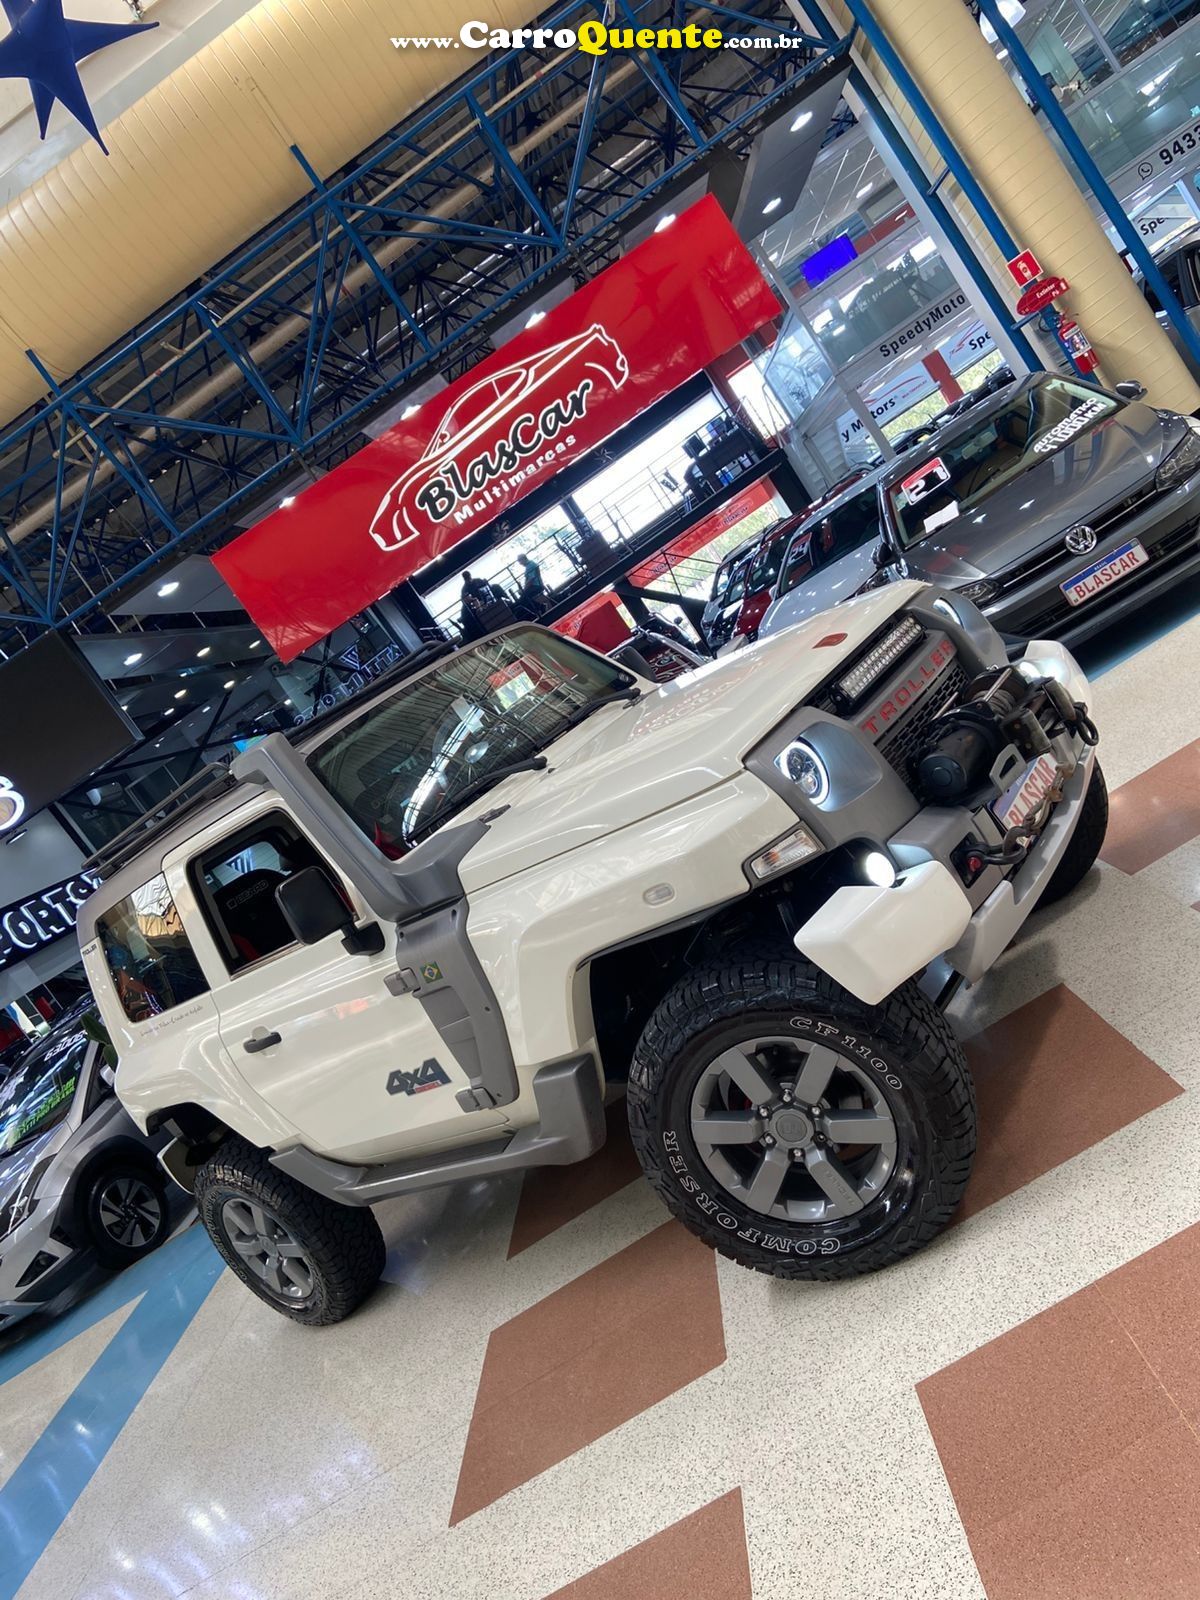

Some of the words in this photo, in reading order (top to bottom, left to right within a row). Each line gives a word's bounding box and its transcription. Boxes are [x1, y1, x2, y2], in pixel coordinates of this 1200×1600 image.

[879, 293, 966, 359] SpeedyMoto
[415, 379, 593, 523] BlasCar
[453, 434, 577, 525] Multimarcas
[1073, 551, 1140, 600] BLASCAR
[861, 639, 954, 735] TROLLER
[1008, 757, 1057, 825] BLASCAR
[662, 1130, 841, 1255] COMFORSER
